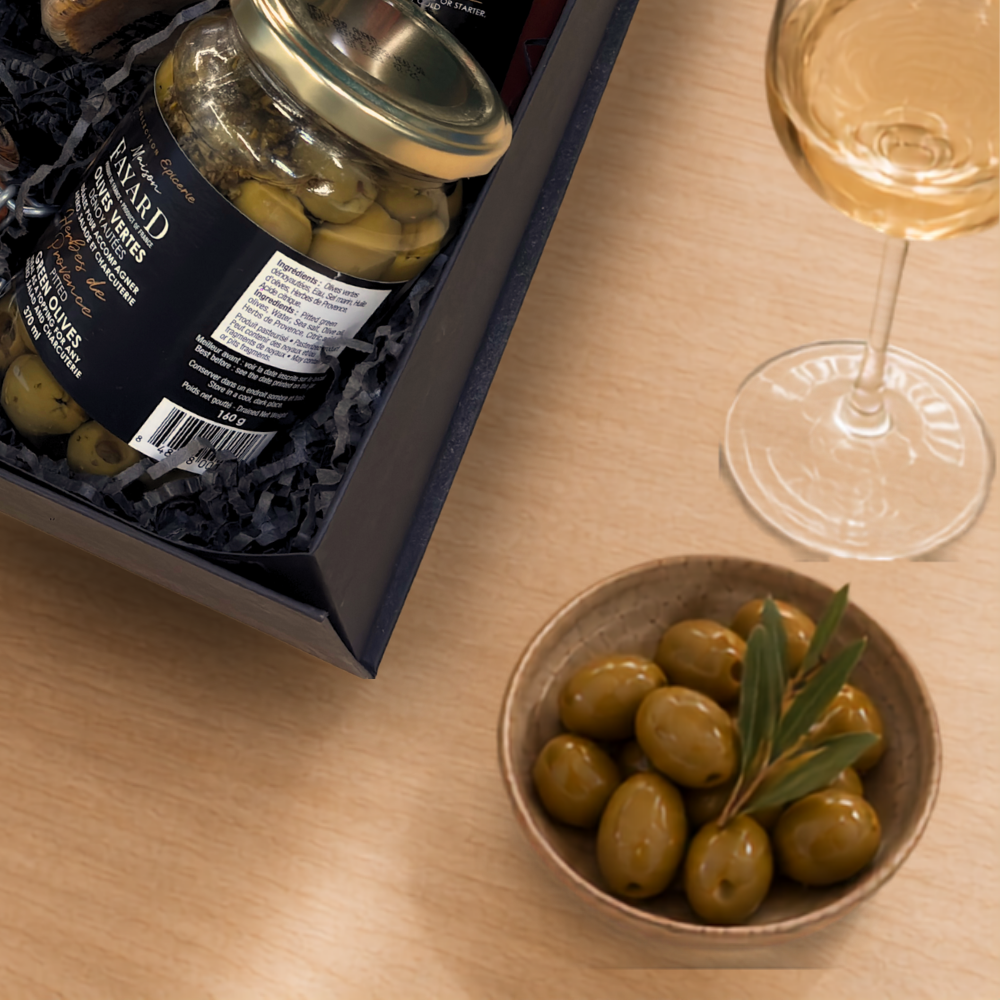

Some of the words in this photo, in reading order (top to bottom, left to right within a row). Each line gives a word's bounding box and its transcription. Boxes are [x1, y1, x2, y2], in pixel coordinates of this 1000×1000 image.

[131, 144, 162, 194] Maison
[109, 136, 169, 240] FAYARD
[94, 166, 113, 212] OLIVES
[111, 209, 147, 263] VERTES
[59, 209, 86, 272] Herbes
[86, 278, 106, 301] de
[93, 231, 140, 295] ACCOMPAGNER
[276, 259, 318, 285] Ingrédients
[47, 232, 93, 318] Provence
[49, 267, 68, 302] PITTED
[95, 251, 136, 306] CHARCUTERIE
[35, 251, 52, 296] GREEN
[49, 295, 82, 348] OLIVES
[242, 303, 264, 318] Herbs
[253, 289, 295, 314] Ingredients
[291, 288, 313, 302] Herbes
[23, 305, 34, 326] 370
[30, 325, 41, 340] ml
[37, 292, 55, 327] TOPPING
[53, 326, 66, 346] FOR
[65, 345, 81, 364] ANY
[224, 326, 256, 347] fragments
[34, 305, 45, 323] AND
[43, 323, 83, 379] CHARCUTERIE
[194, 344, 211, 359] Best
[210, 353, 232, 369] before
[221, 349, 242, 364] avant
[188, 359, 221, 381] Conserver
[207, 380, 226, 393] Store
[181, 380, 200, 397] Poids
[236, 405, 260, 417] Drained
[217, 409, 237, 422] 160
[236, 417, 247, 426] g
